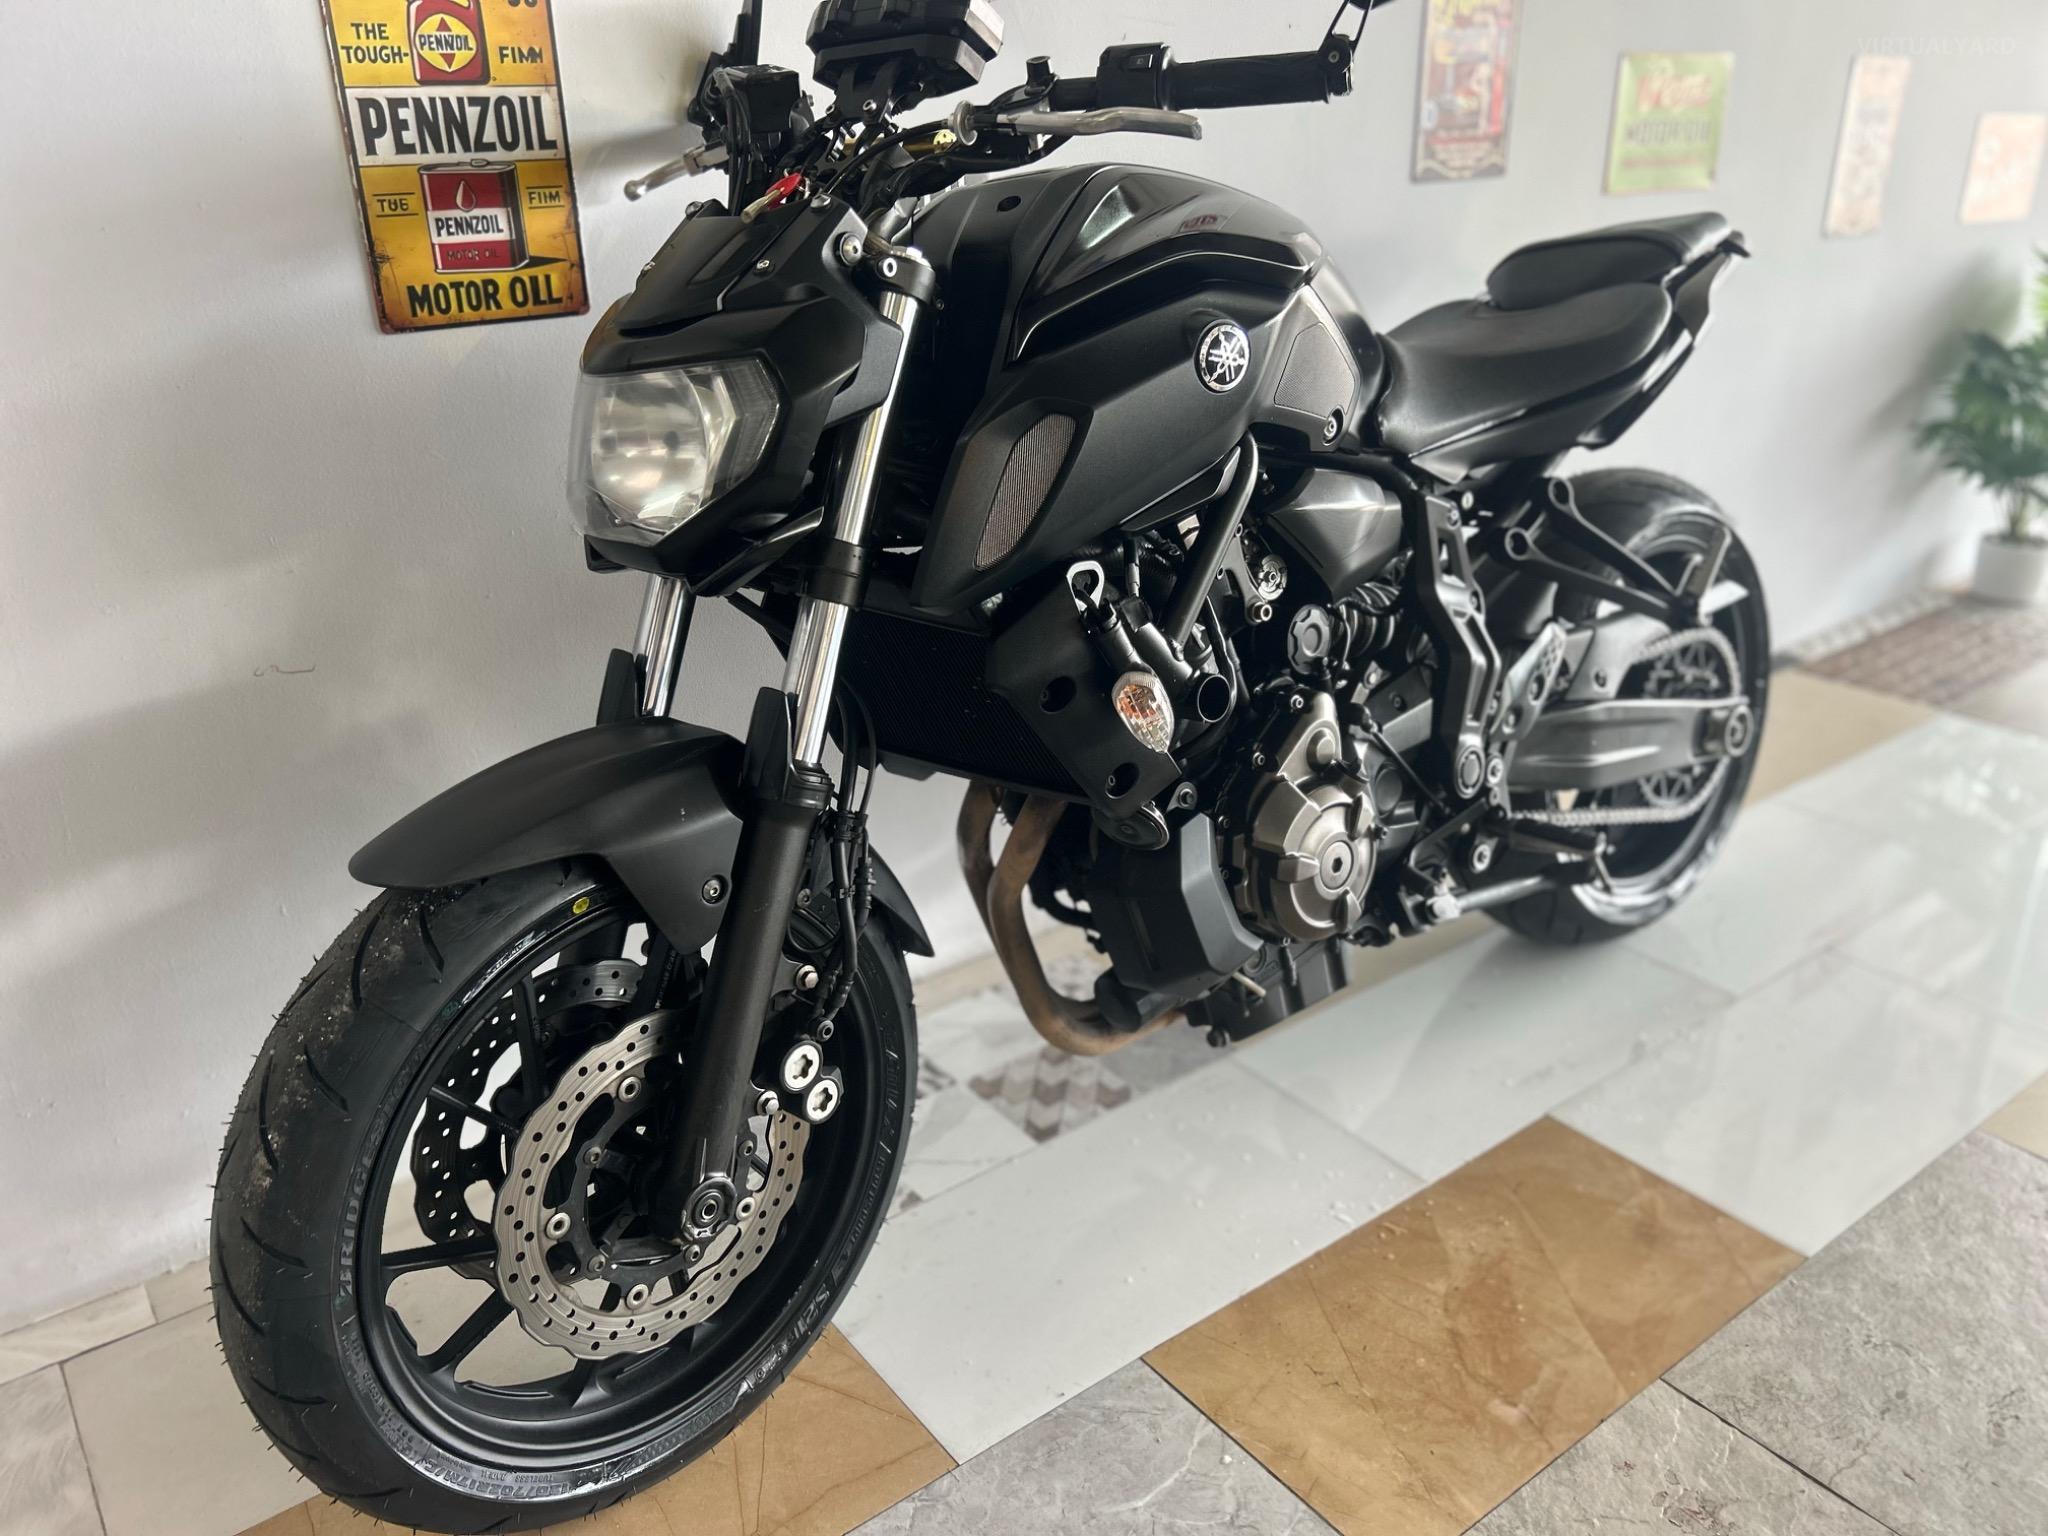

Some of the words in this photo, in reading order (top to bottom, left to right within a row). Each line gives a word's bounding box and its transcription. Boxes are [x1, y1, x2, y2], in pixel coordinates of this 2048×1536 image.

[351, 23, 389, 40] THE
[418, 34, 474, 51] PENNZOIL
[341, 45, 409, 64] TOUGH-
[355, 95, 558, 156] PENNZOIL
[434, 214, 504, 238] PENNZOIL
[406, 278, 503, 318] MOTOR
